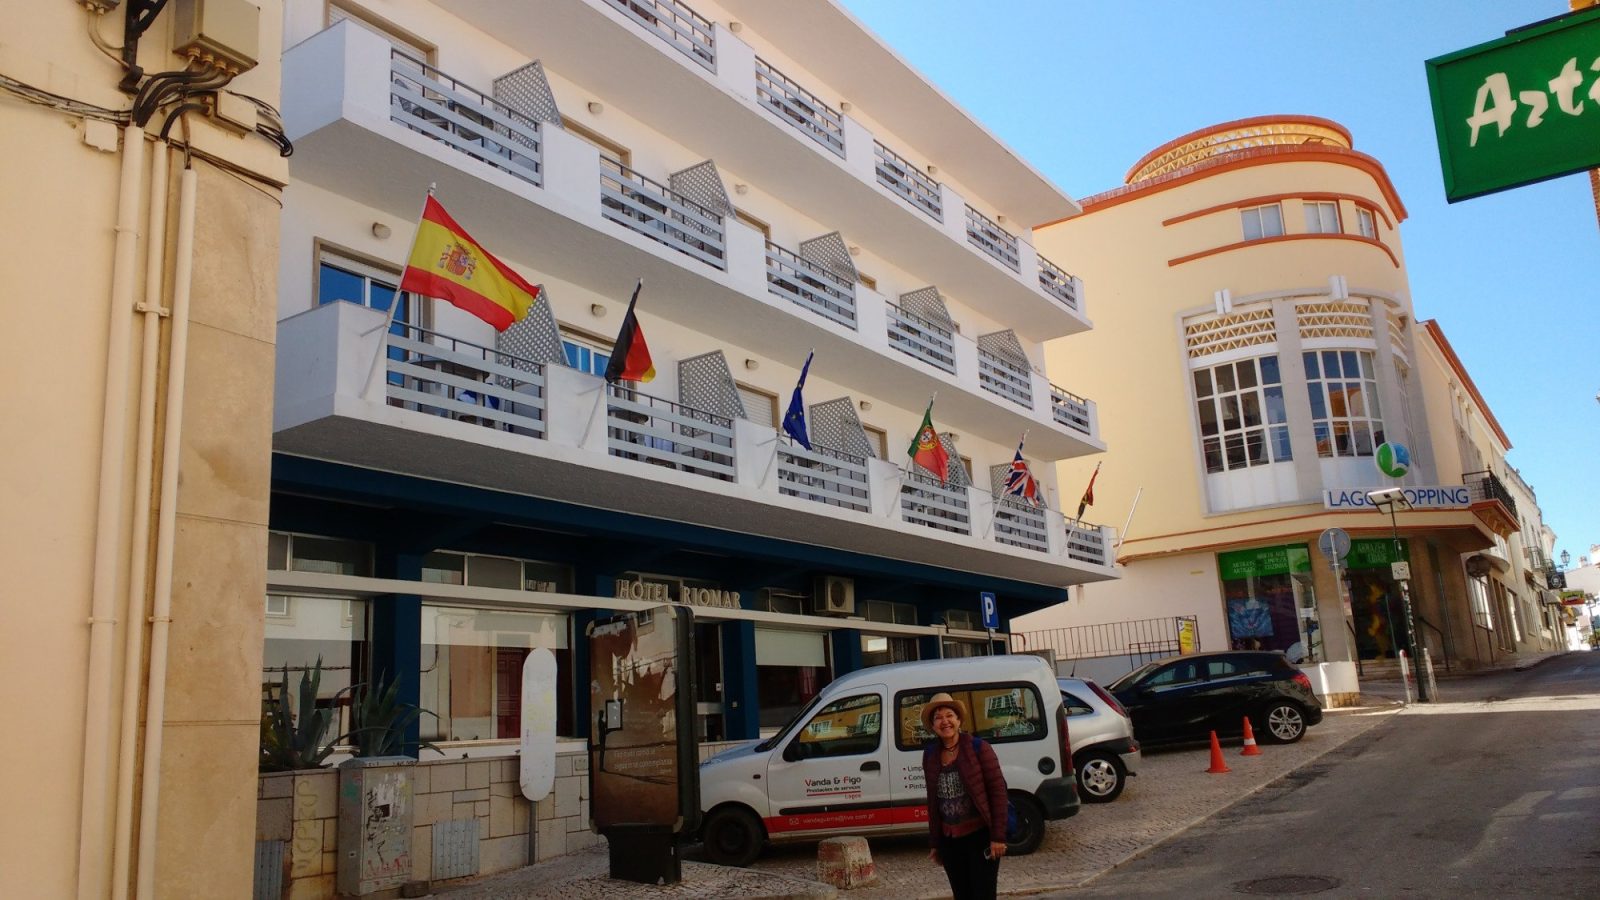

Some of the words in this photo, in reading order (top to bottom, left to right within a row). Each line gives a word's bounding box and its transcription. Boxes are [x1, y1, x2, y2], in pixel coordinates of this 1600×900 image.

[1329, 490, 1376, 506] LAG
[1403, 488, 1469, 505] OPPING
[616, 580, 672, 602] HOTEL
[681, 586, 742, 609] RIOMAR
[984, 596, 994, 624] P
[804, 778, 831, 787] Vanda
[833, 777, 841, 785] &
[843, 776, 861, 786] Figo
